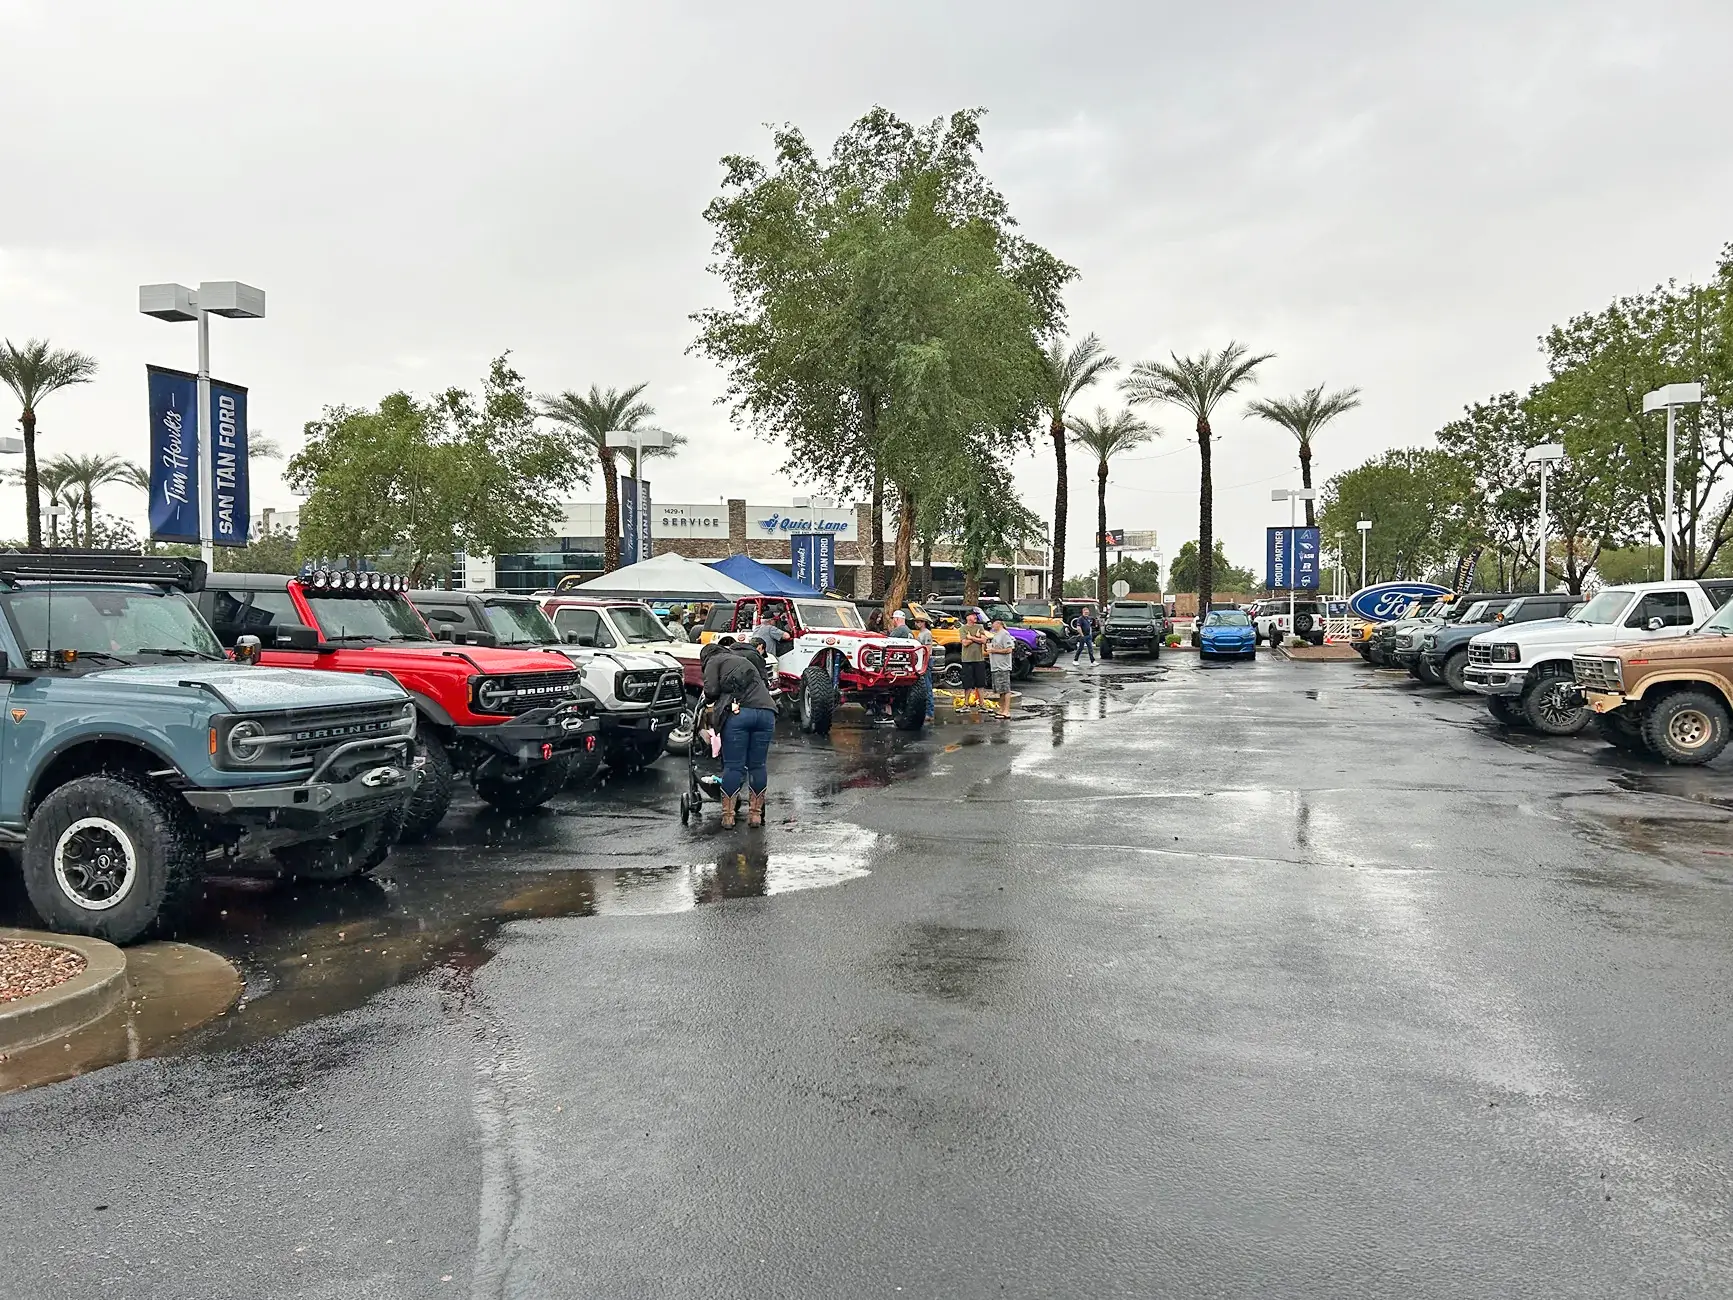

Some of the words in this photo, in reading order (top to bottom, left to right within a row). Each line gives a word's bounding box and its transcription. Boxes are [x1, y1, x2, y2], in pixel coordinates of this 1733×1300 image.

[218, 395, 236, 449] FORD
[217, 452, 236, 489] TAN
[163, 470, 189, 505] Tim
[218, 493, 234, 535] SAN
[662, 517, 719, 528] SERVICE
[818, 519, 848, 531] Lane
[820, 537, 829, 557] FORD
[1274, 530, 1284, 562] PARTNER
[820, 557, 829, 572] TAN
[1274, 563, 1284, 587] PROUD
[516, 685, 570, 696] BRONCO
[296, 722, 391, 740] BRONCO
